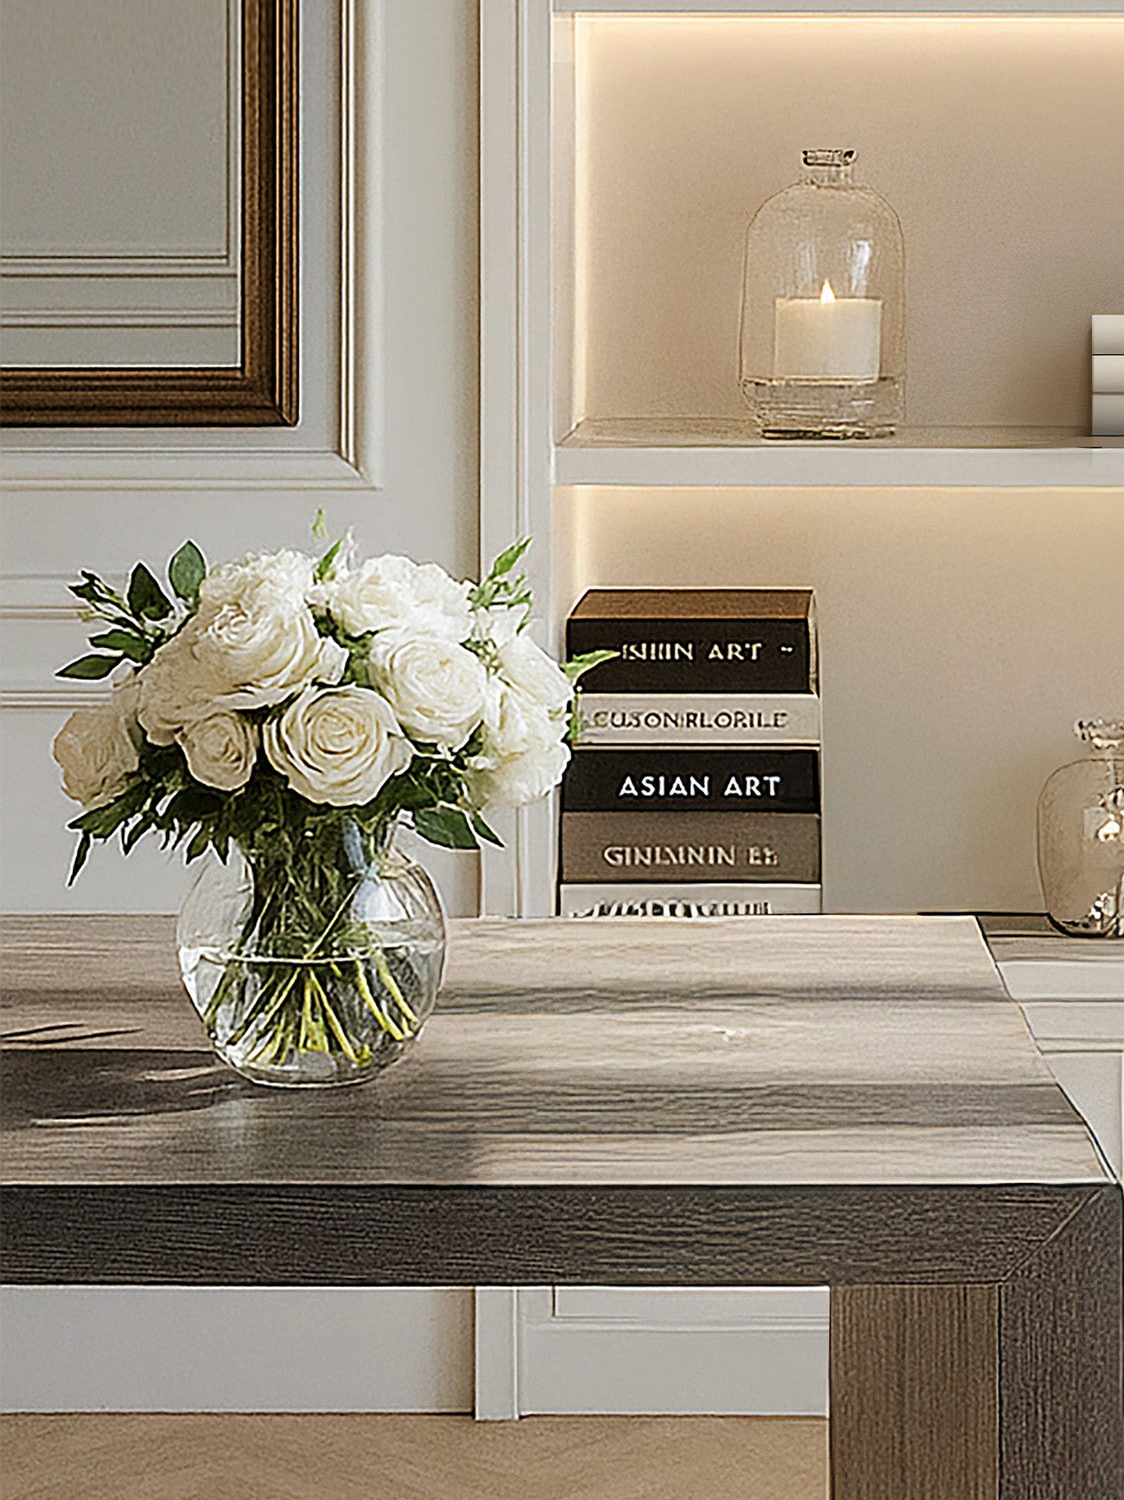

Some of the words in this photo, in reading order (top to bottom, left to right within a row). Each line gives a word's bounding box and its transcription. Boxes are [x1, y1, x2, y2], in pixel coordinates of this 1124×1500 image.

[708, 643, 763, 661] ART
[619, 776, 710, 797] ASIAN
[724, 776, 782, 797] ART
